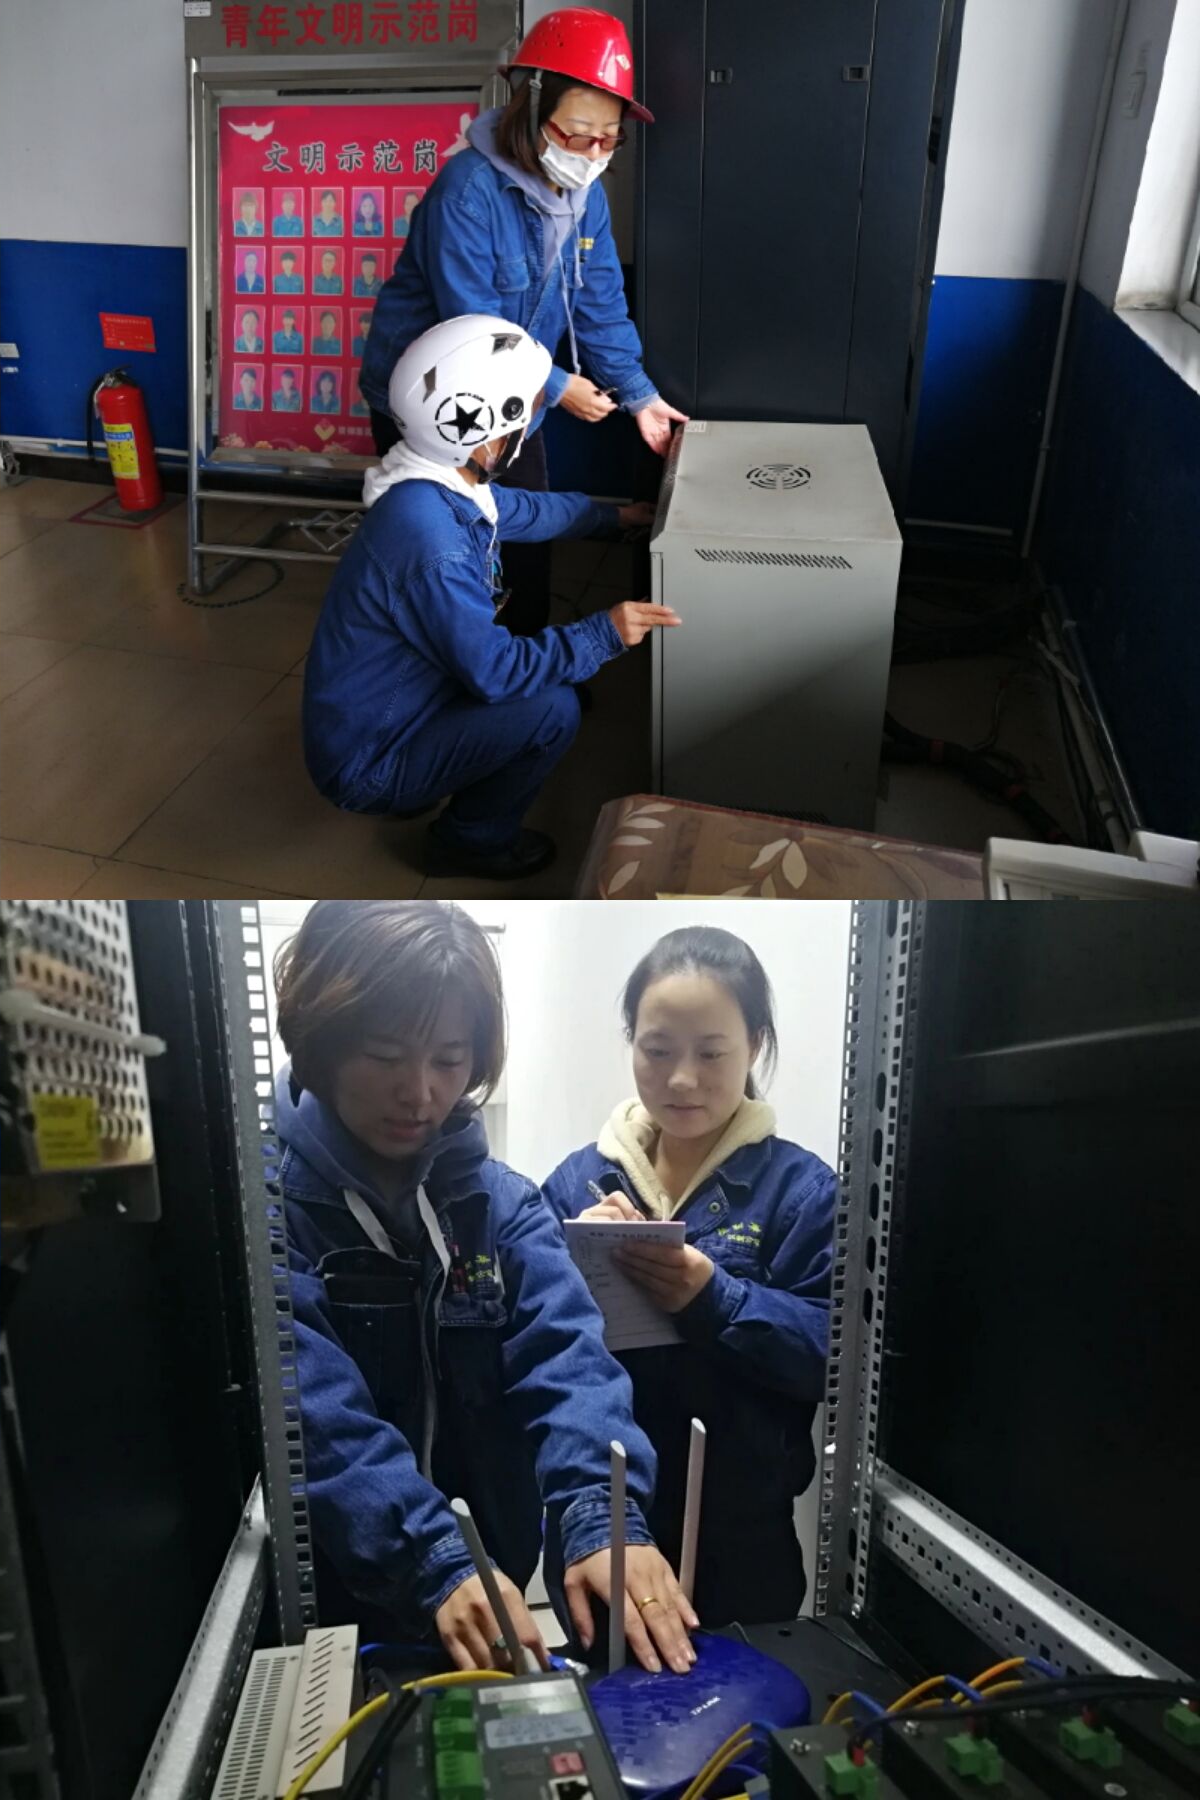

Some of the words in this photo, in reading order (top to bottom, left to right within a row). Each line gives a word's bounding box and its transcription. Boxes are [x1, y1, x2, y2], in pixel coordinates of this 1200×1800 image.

[220, 0, 479, 48] 青年文明示范岗
[262, 139, 439, 175] 文明示范岗
